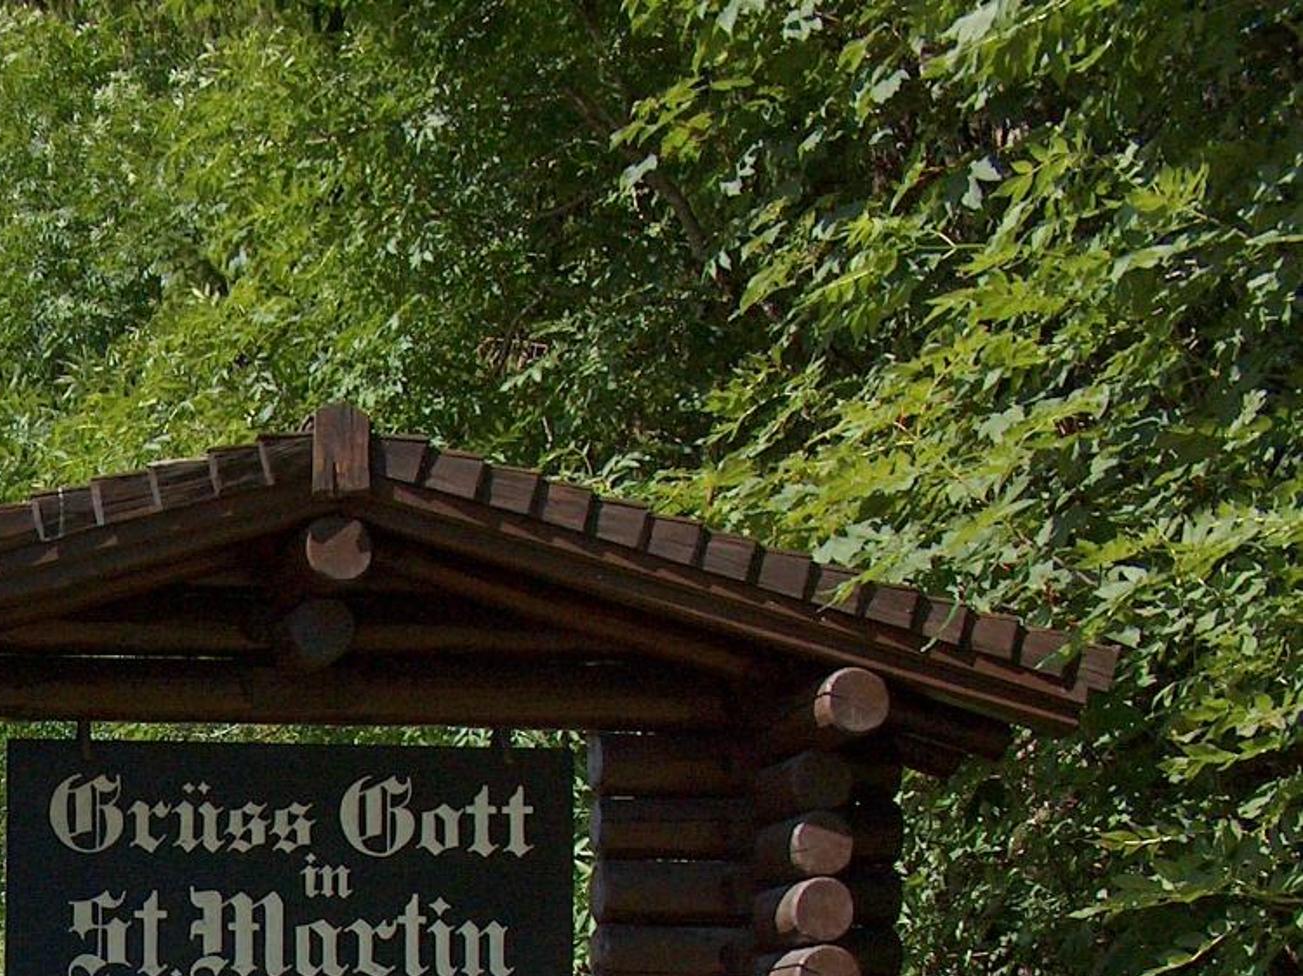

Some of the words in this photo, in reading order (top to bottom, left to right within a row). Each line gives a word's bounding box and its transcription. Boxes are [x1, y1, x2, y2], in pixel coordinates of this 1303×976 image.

[49, 773, 317, 857] Grüss
[339, 775, 534, 859] Gott
[300, 853, 353, 899] in
